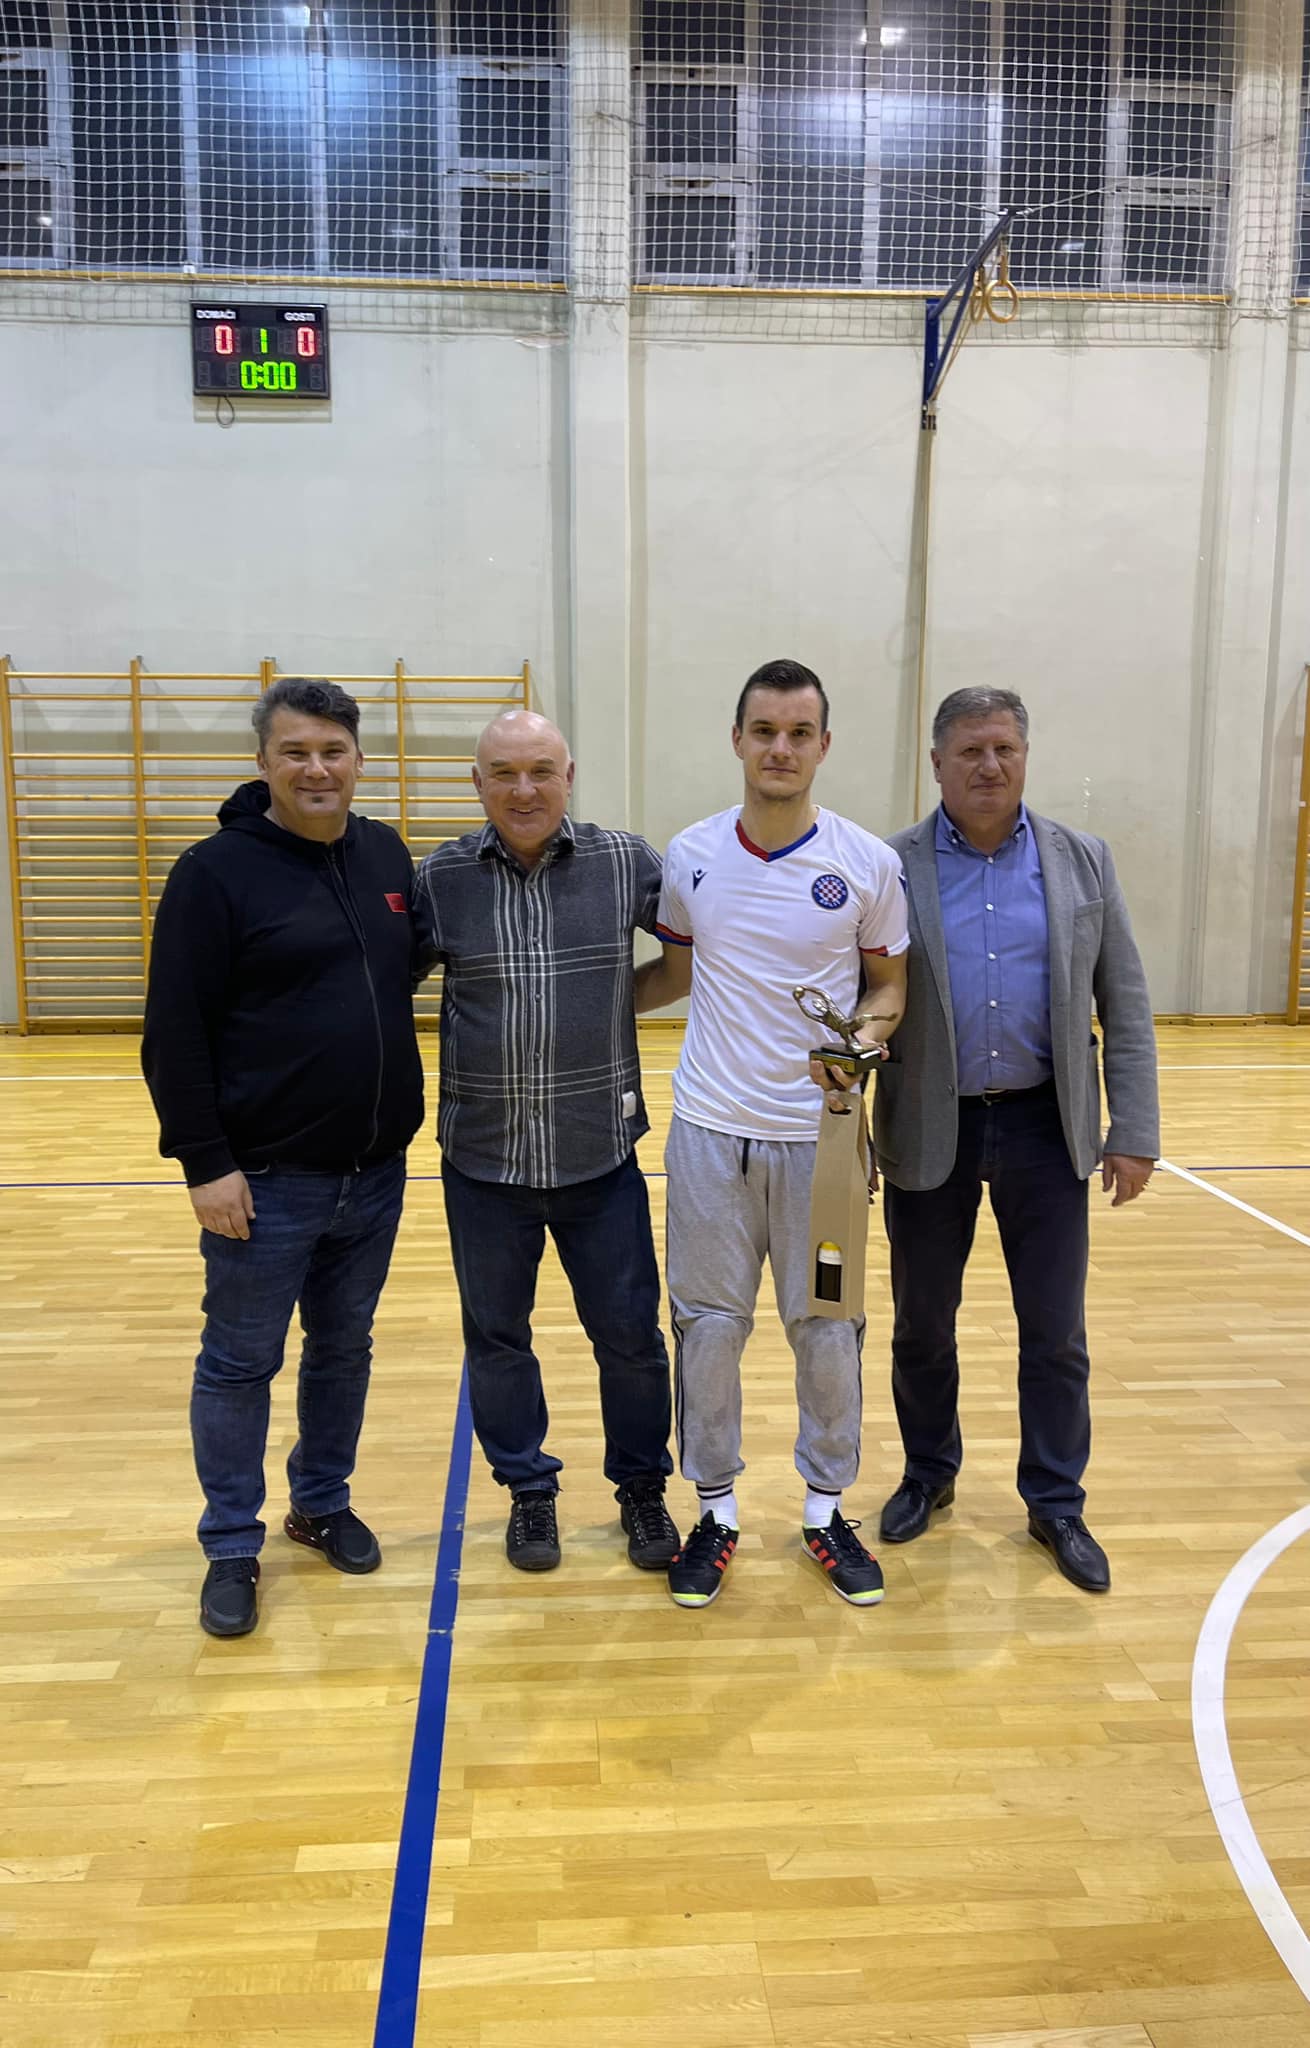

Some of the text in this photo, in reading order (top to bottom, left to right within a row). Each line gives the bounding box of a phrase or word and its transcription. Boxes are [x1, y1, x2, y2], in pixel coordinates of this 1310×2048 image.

[284, 311, 316, 322] GOSTI
[215, 325, 233, 354] 0
[260, 328, 268, 353] 1
[297, 327, 315, 356] 0
[240, 360, 297, 390] 0:00
